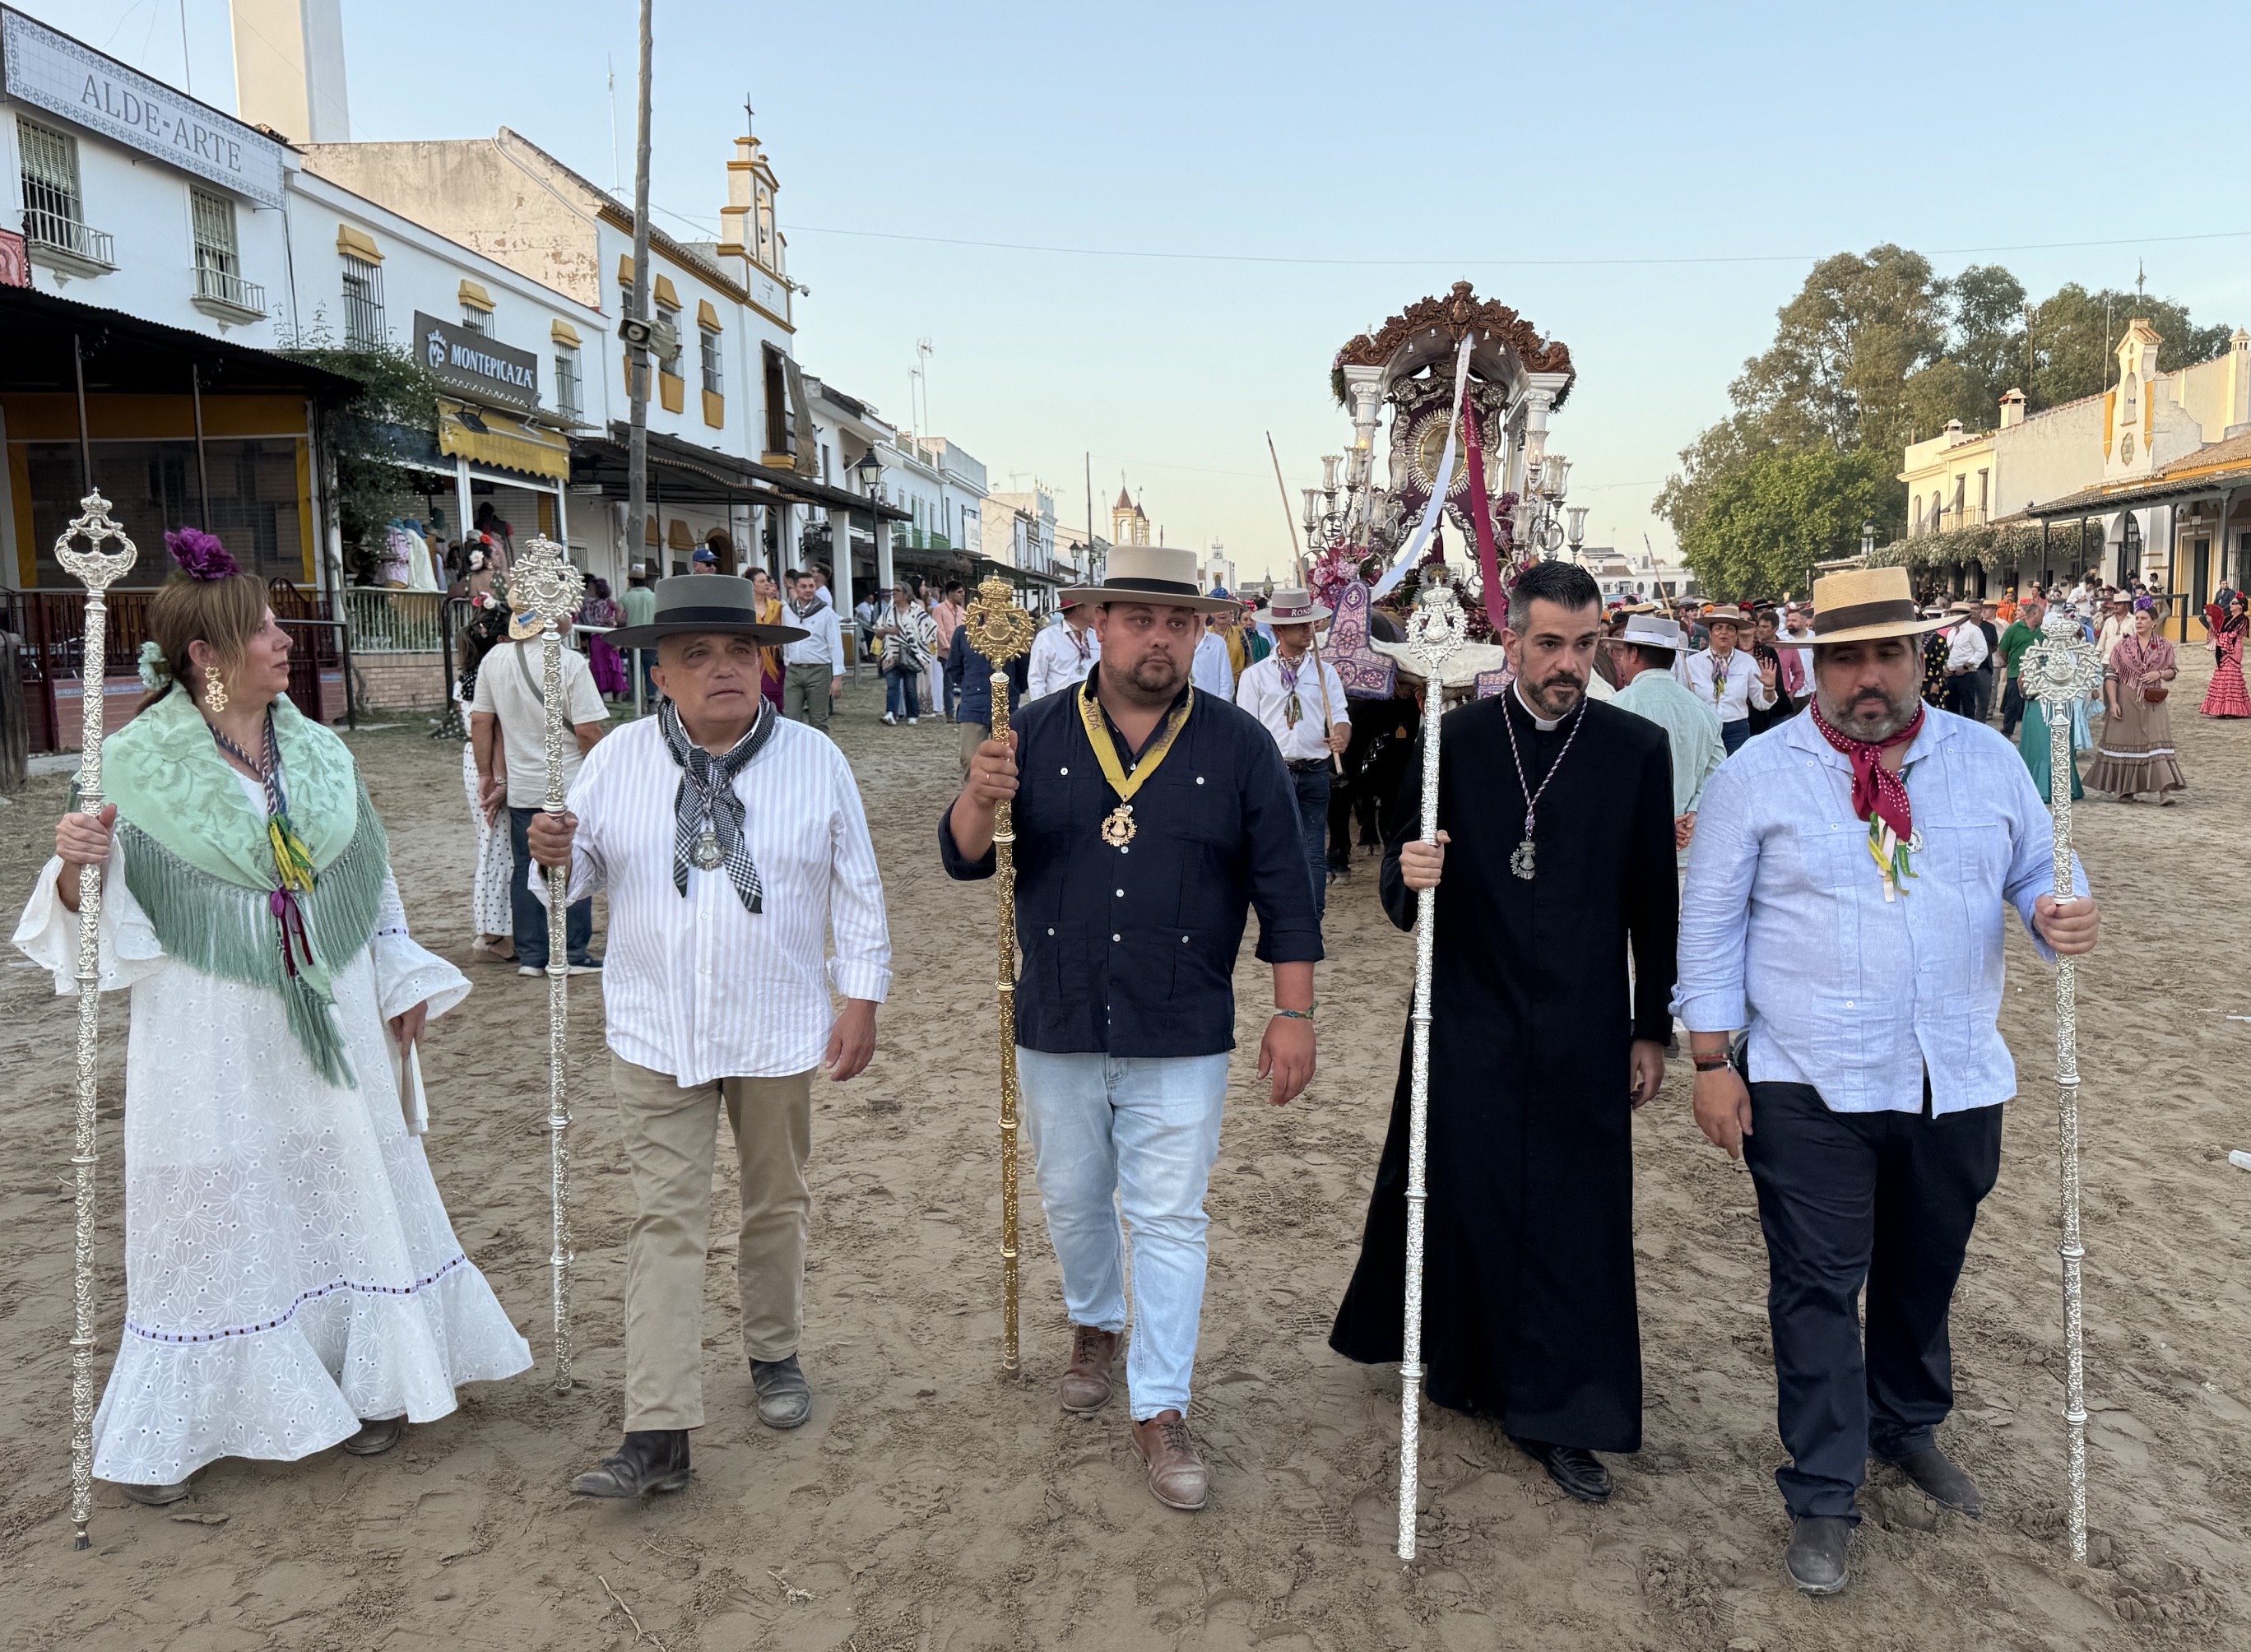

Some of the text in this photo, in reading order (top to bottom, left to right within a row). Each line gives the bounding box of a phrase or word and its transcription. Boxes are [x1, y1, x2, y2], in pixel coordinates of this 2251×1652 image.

[80, 74, 242, 174] ALDE-ARTE
[450, 343, 534, 390] MONTEPICAZA
[1080, 694, 1104, 731] ONDA
